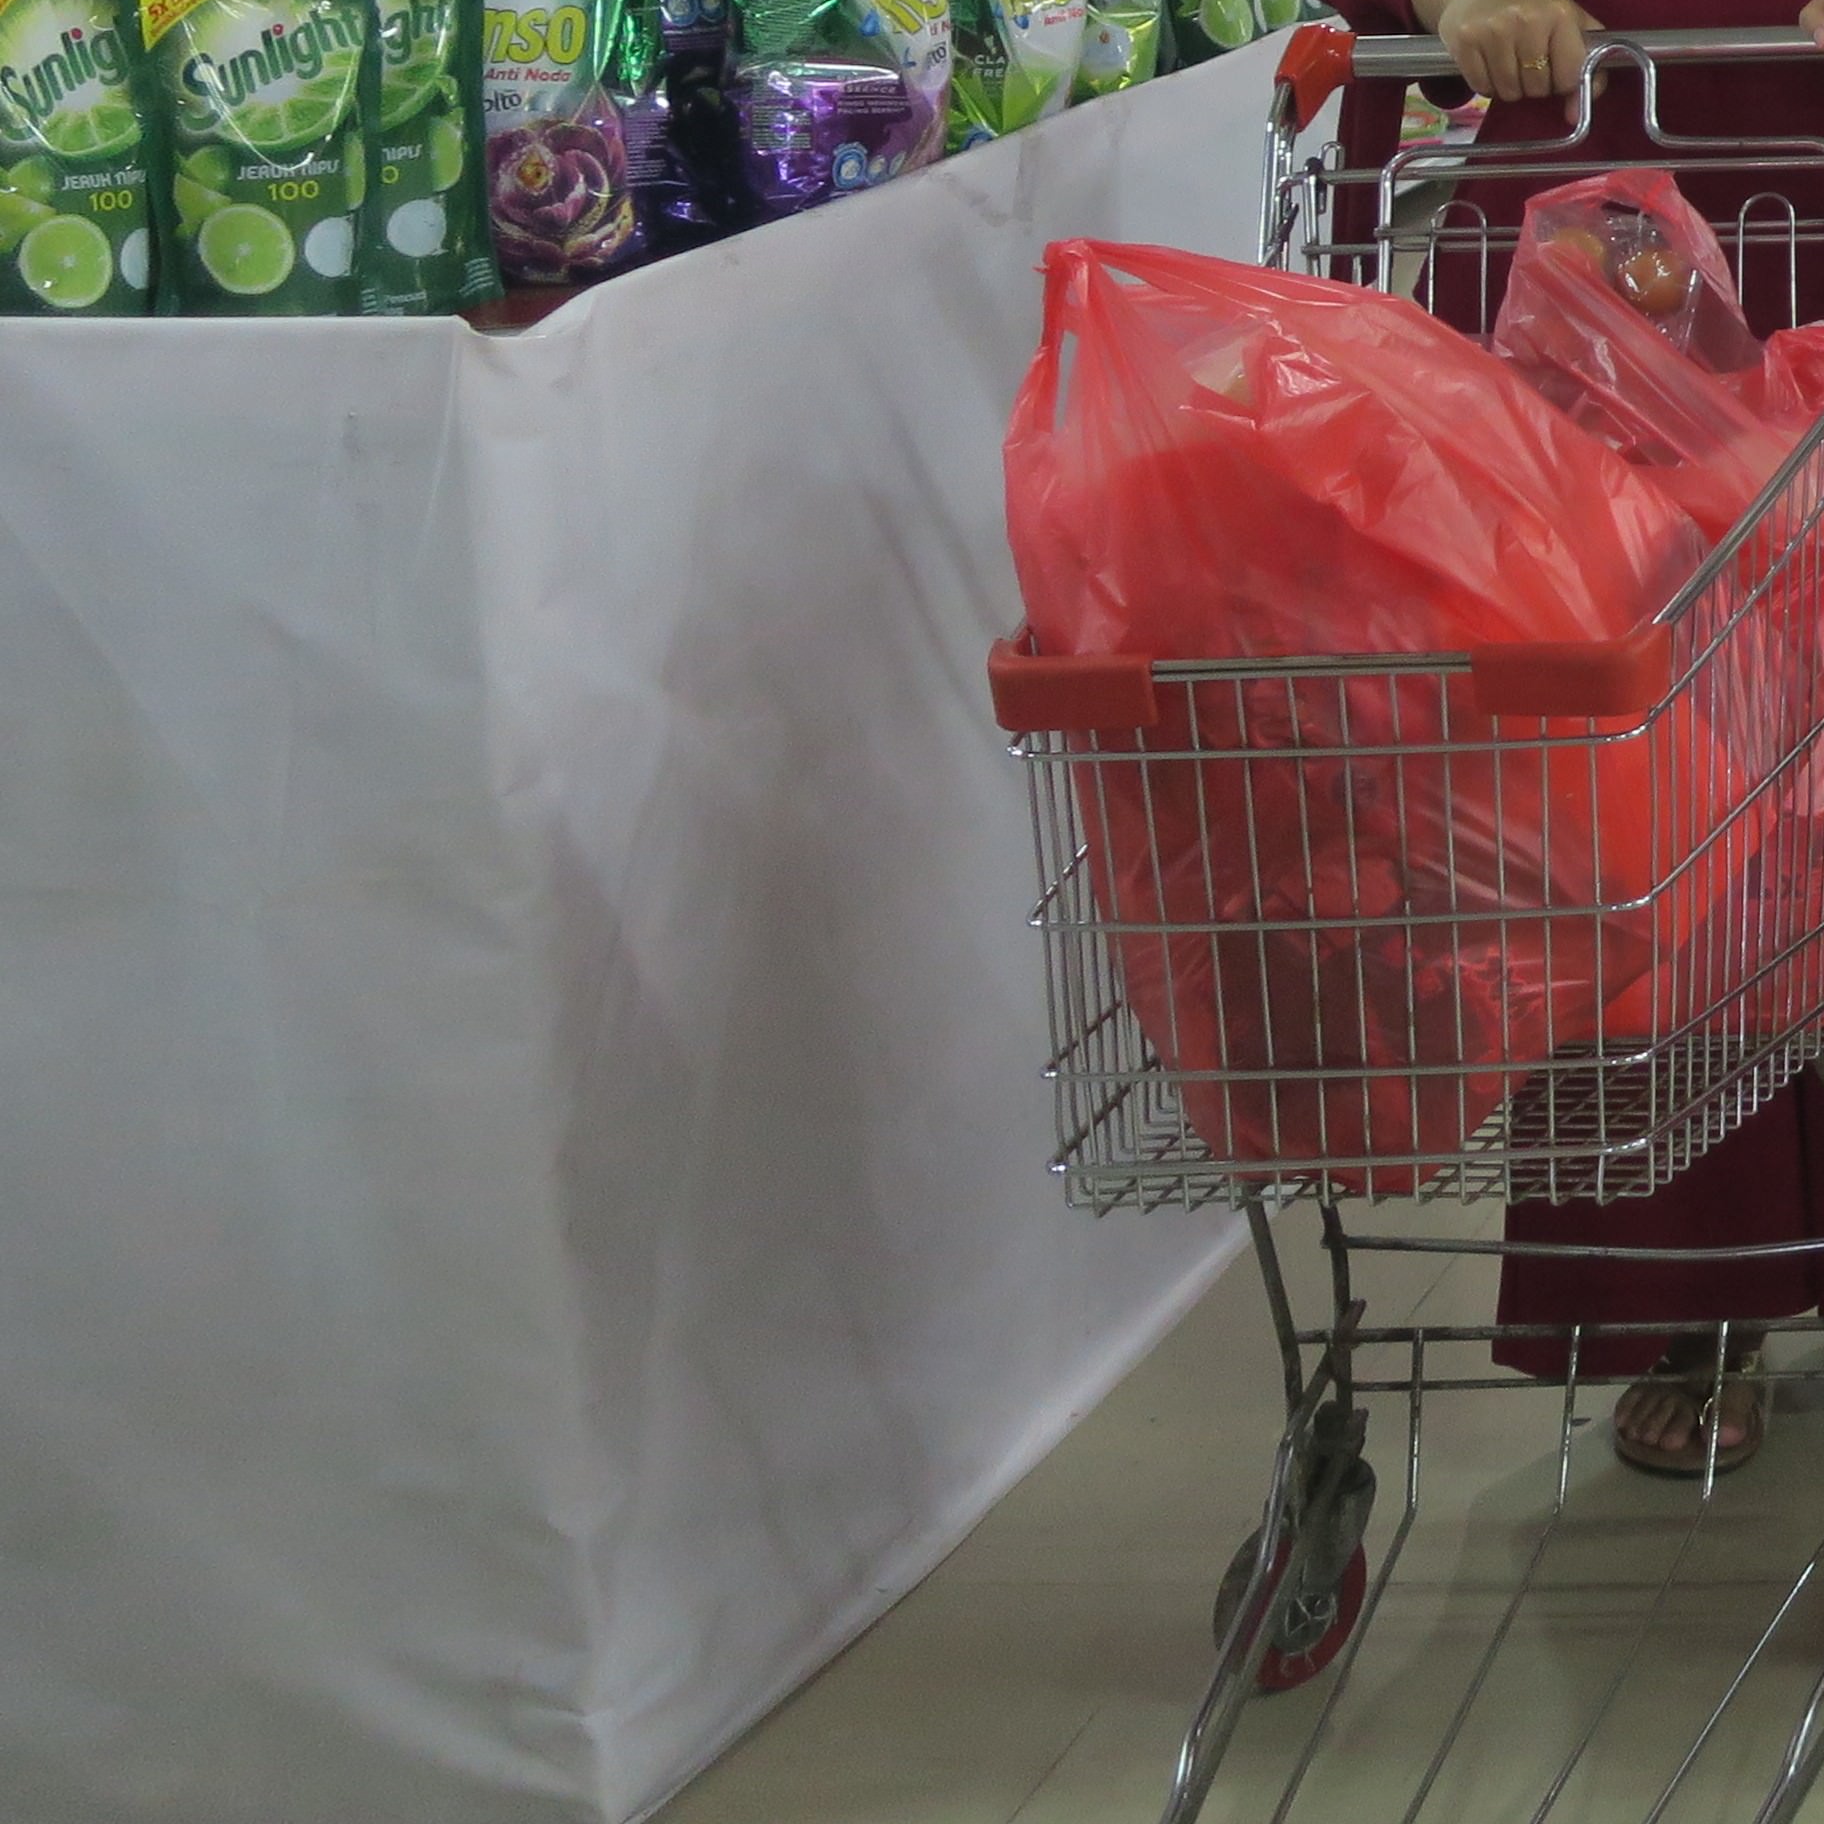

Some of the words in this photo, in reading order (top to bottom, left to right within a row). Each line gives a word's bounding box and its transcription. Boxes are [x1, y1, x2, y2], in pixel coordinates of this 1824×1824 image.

[180, 6, 364, 131] Sunlight
[525, 67, 570, 82] Noda
[88, 190, 133, 212] 100
[267, 180, 320, 201] 100
